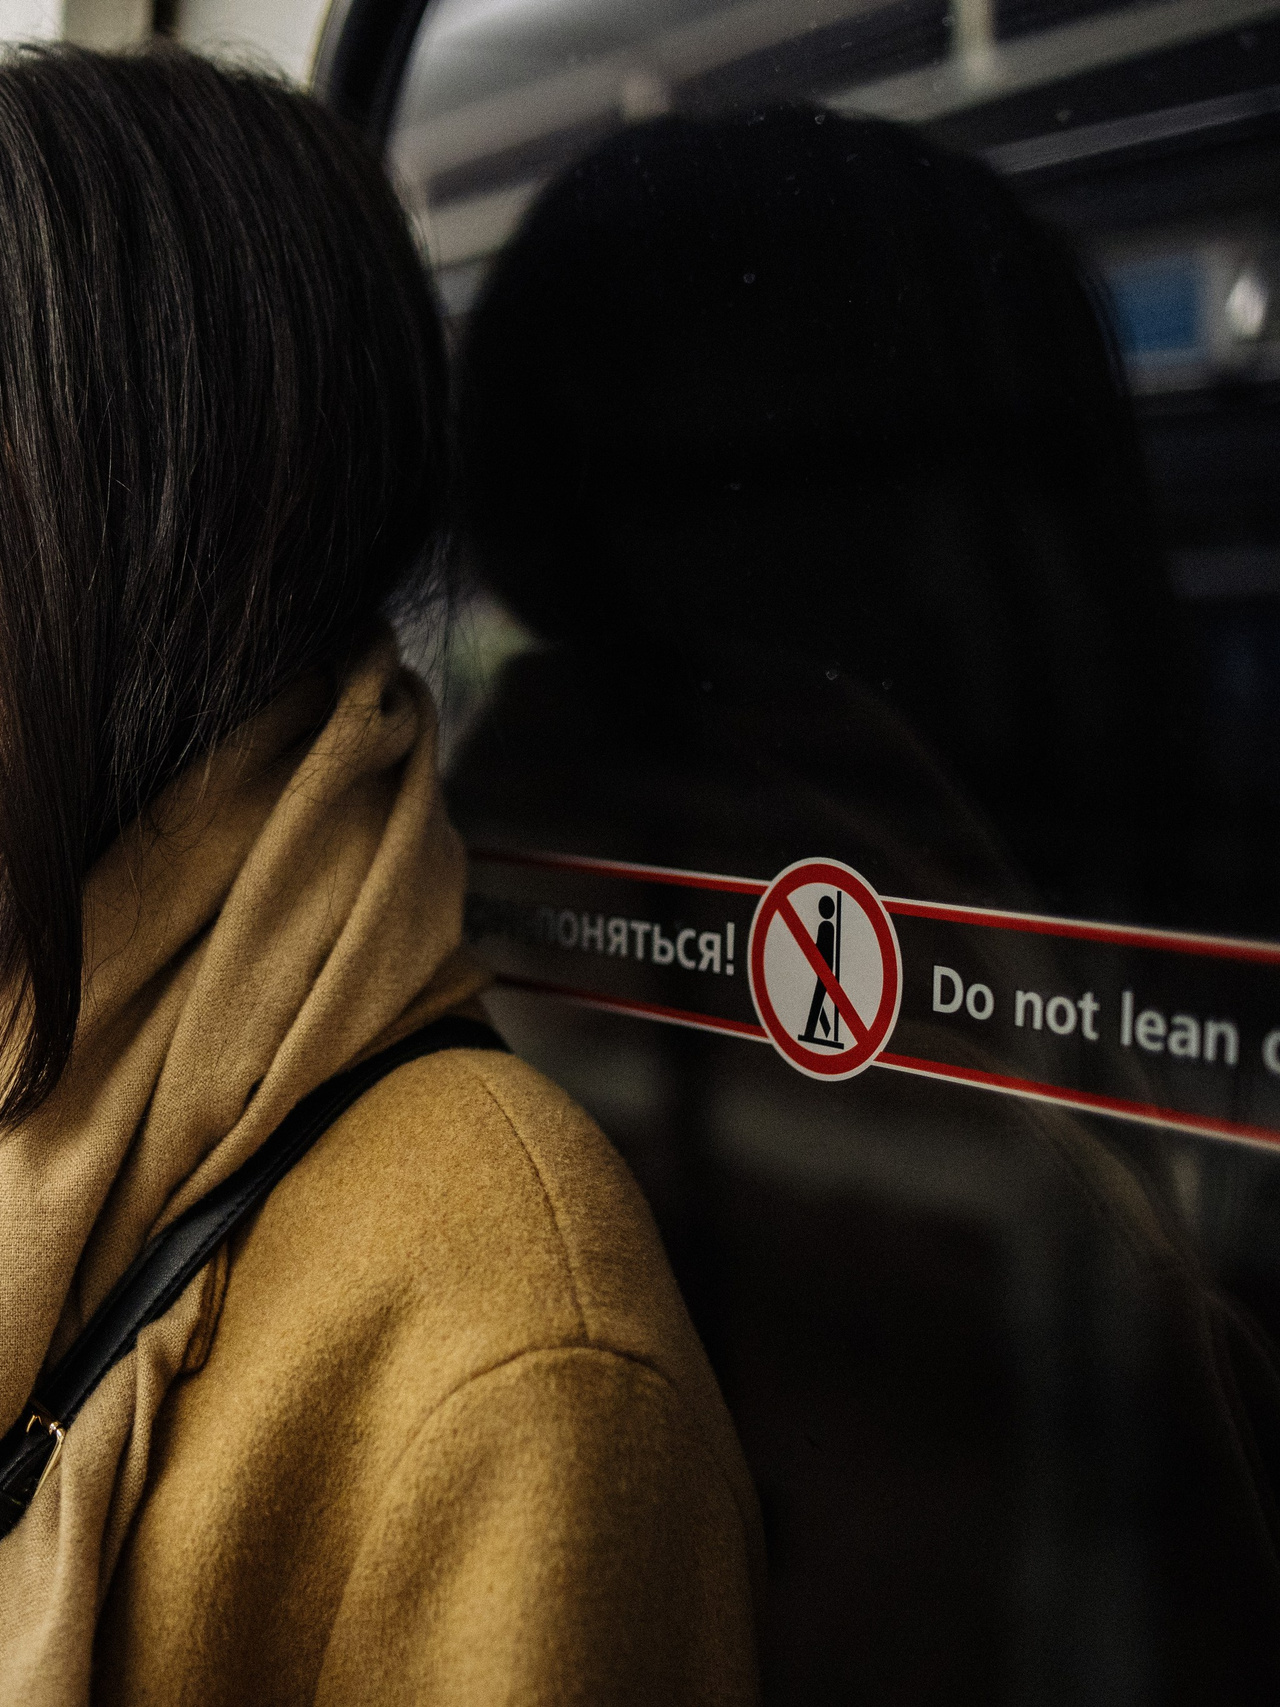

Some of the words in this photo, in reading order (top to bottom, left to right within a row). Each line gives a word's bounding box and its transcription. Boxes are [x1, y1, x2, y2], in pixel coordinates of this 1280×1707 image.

[933, 965, 994, 1021] Do
[1015, 990, 1100, 1041] not
[1120, 990, 1240, 1066] lean
